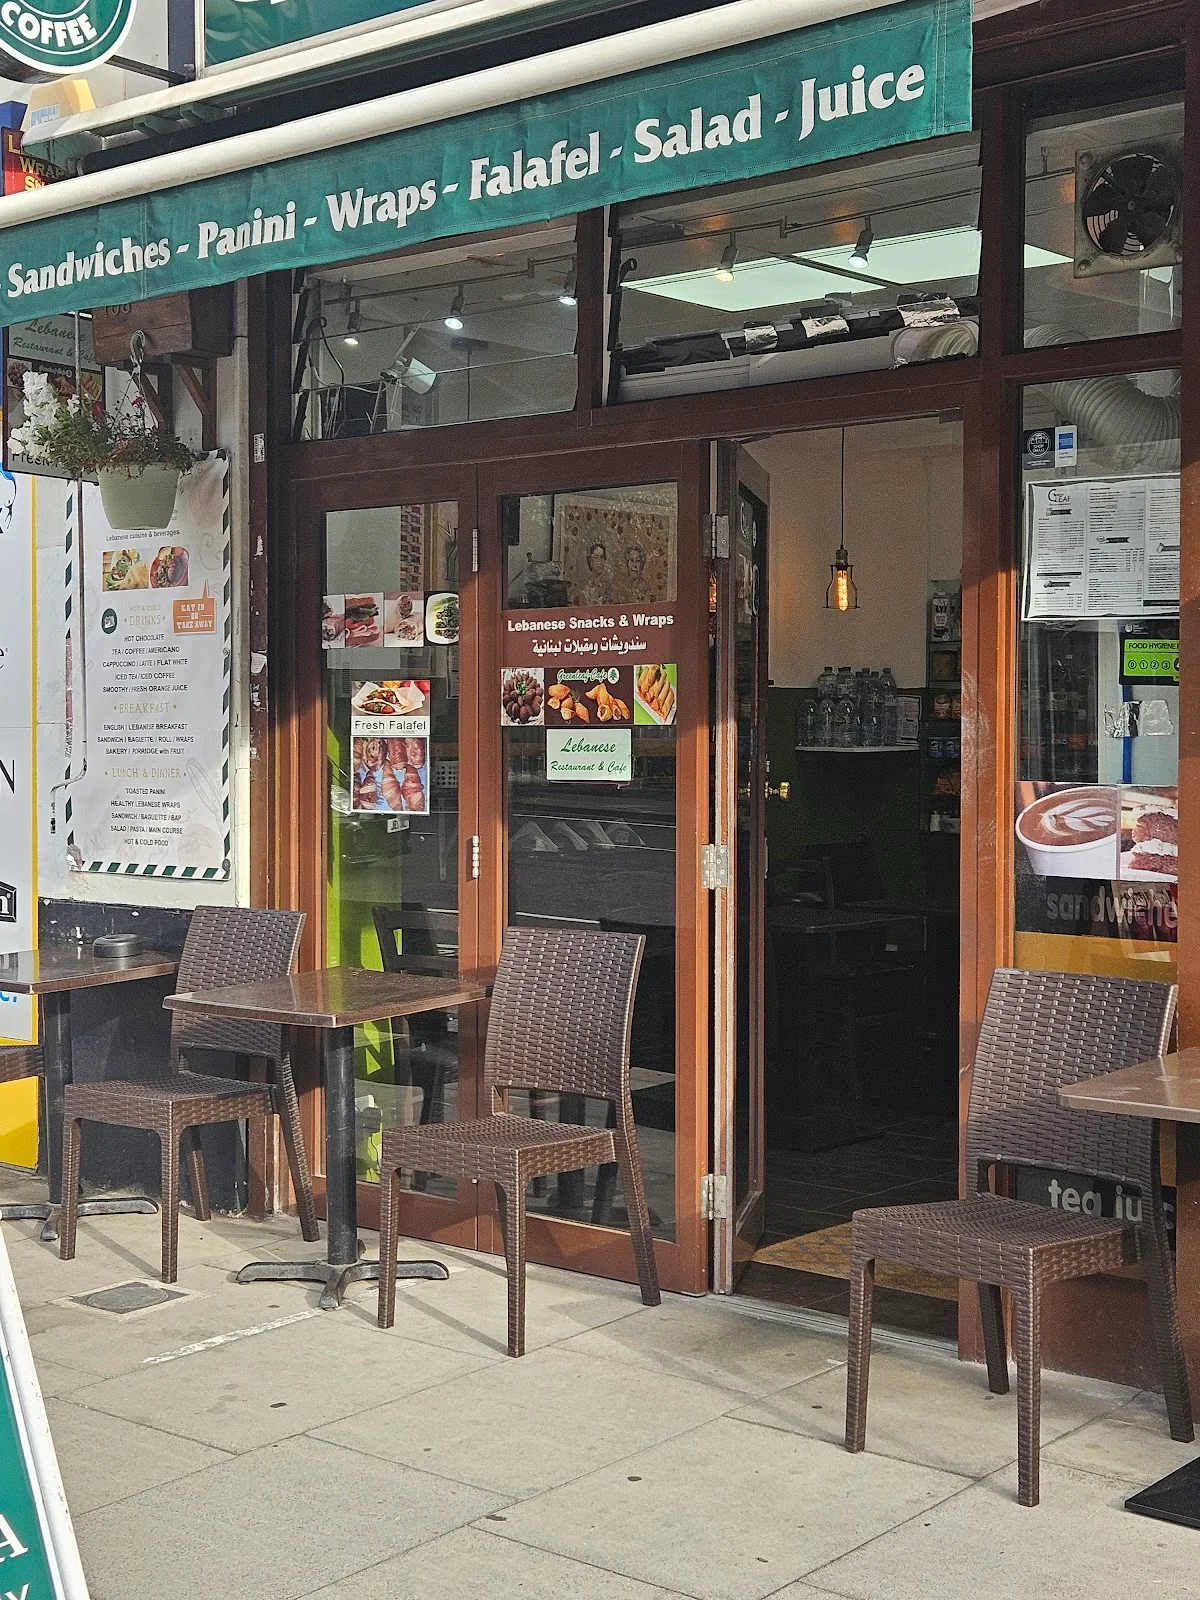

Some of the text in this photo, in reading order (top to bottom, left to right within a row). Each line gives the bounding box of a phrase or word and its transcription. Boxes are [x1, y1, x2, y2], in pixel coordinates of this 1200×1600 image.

[1, 1, 97, 48] COFFEE
[8, 237, 171, 298] Sandwiches
[197, 201, 298, 260] Panini
[326, 179, 437, 232] Wraps
[469, 131, 600, 201] Falafel
[634, 94, 762, 164] Salad
[799, 64, 925, 141] Juice
[25, 320, 86, 341] Lebanee
[13, 337, 64, 356] Restaurant
[66, 348, 75, 357] &
[106, 534, 129, 542] Lebanese
[130, 531, 147, 539] cuisine
[154, 529, 180, 538] beverages
[181, 604, 195, 612] EAT
[129, 614, 161, 626] DRINKS
[191, 611, 199, 620] OR
[177, 620, 213, 629] TAKE AWAY
[507, 614, 674, 632] Lebanese Snacks & Wraps
[136, 633, 165, 641] CHOCOLATE
[125, 647, 145, 655] COFFEE
[557, 668, 608, 684] Greenleaf Cafe
[120, 703, 170, 714] BREAKFAST
[355, 721, 426, 730] Fresh Falafel
[560, 737, 617, 753] Lebanese
[112, 768, 181, 779] LUNCH & DINNER
[550, 760, 628, 775] Restaurant & Cafe
[1047, 886, 1178, 929] sandwiche
[1048, 1178, 1101, 1215] tea
